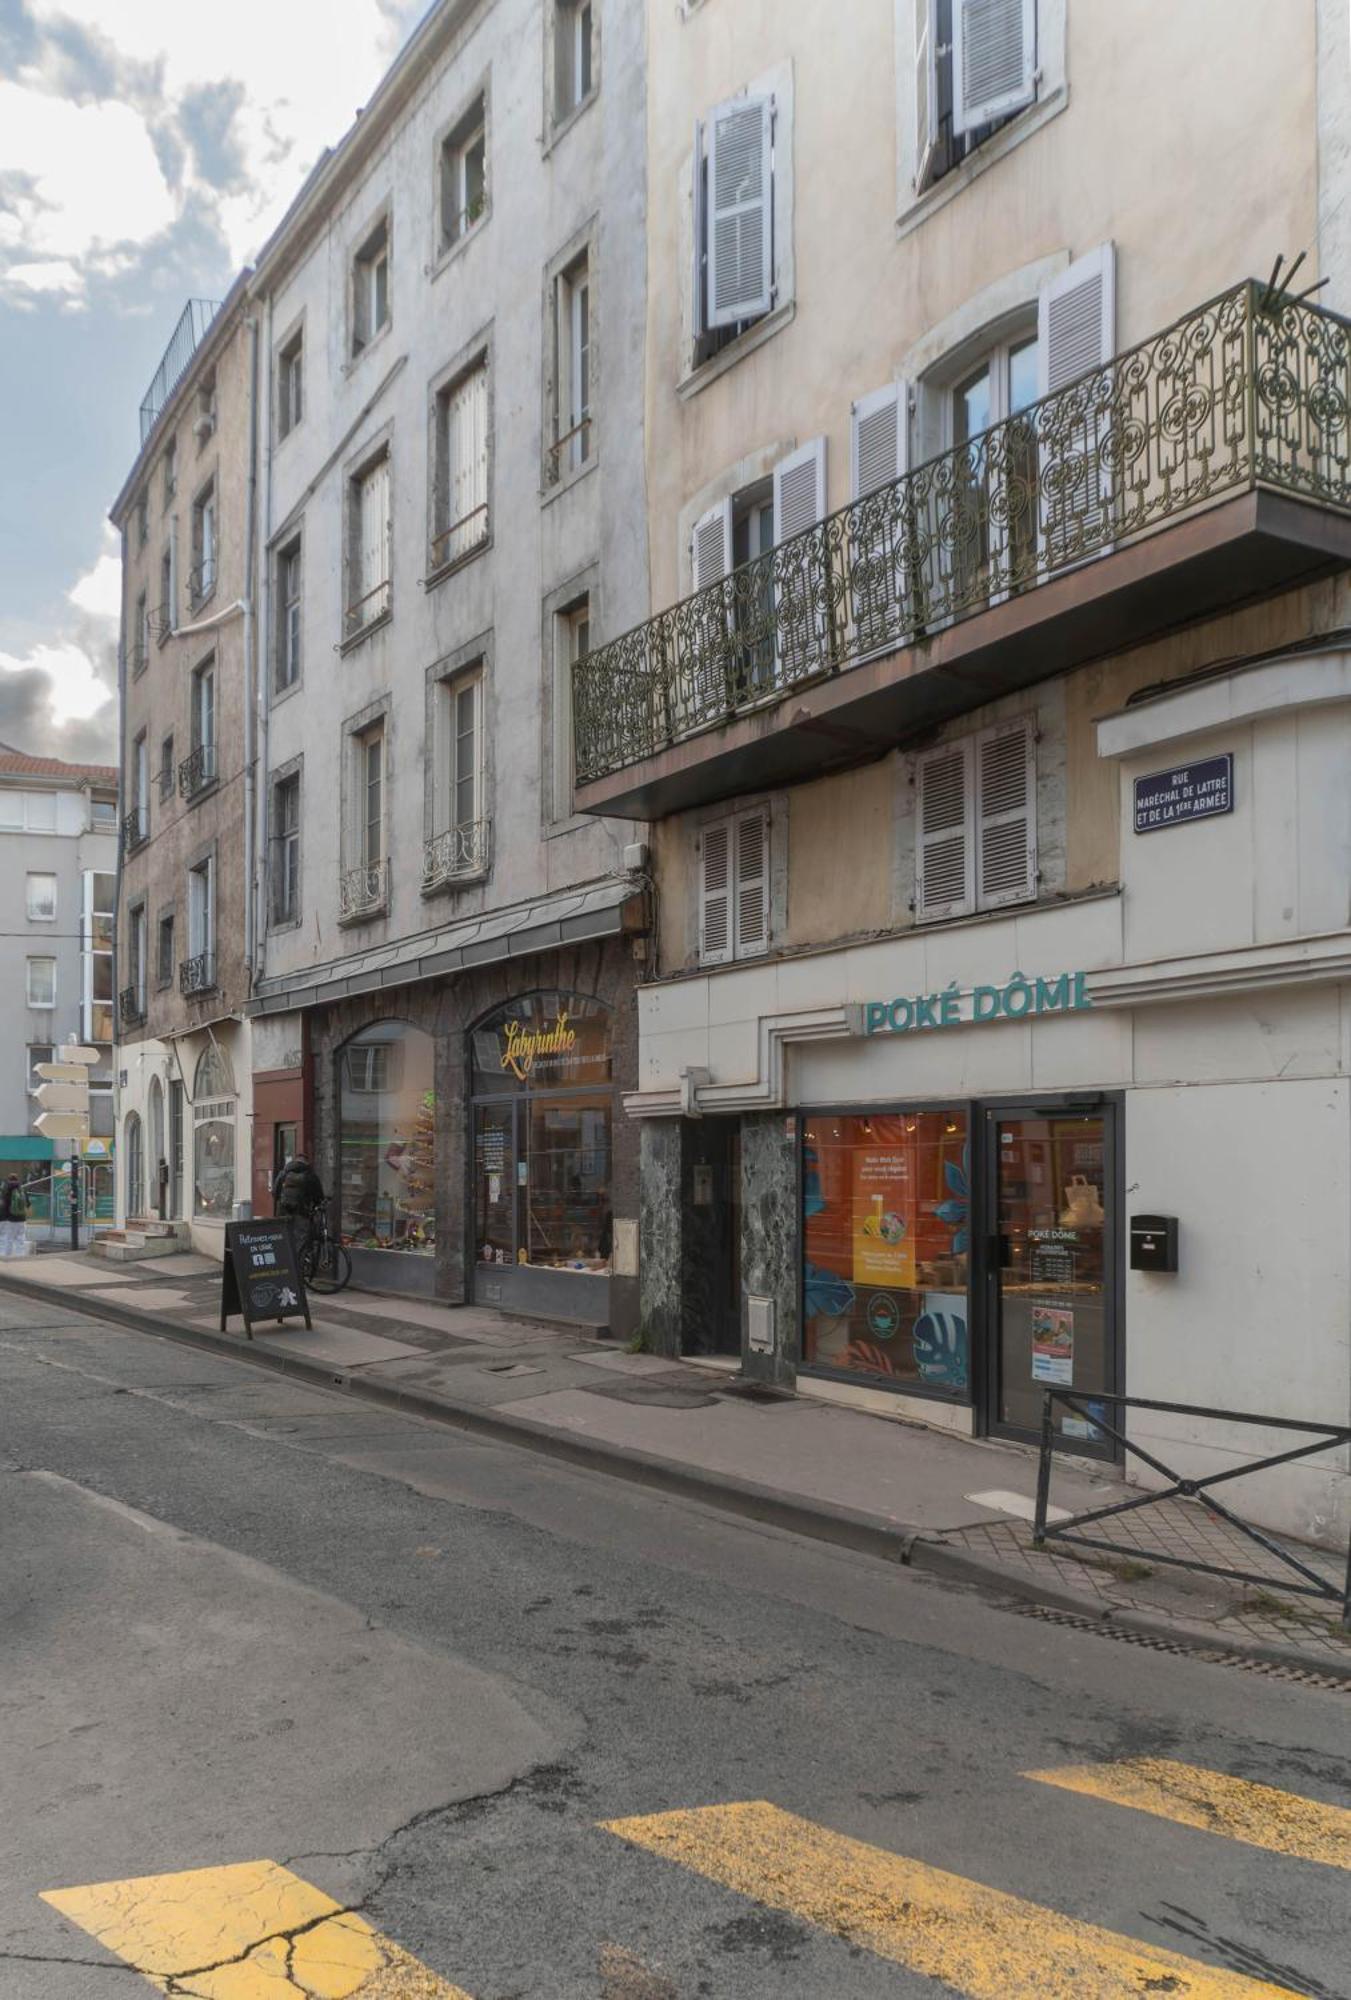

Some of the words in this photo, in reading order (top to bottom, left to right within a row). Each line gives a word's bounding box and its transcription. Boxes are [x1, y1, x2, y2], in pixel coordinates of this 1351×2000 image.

[1137, 791, 1181, 810] MARÉCHAL
[1183, 785, 1194, 798] DE
[1197, 776, 1227, 794] LATTRE
[1171, 771, 1189, 786] RUE
[1137, 812, 1147, 825] ET
[1149, 808, 1161, 822] DE
[1163, 805, 1175, 819] LA
[1193, 791, 1227, 812] ARMÉE
[866, 980, 961, 1036] POKÉ
[972, 970, 1092, 1025] DÔME
[501, 1012, 577, 1081] Labyrinthe
